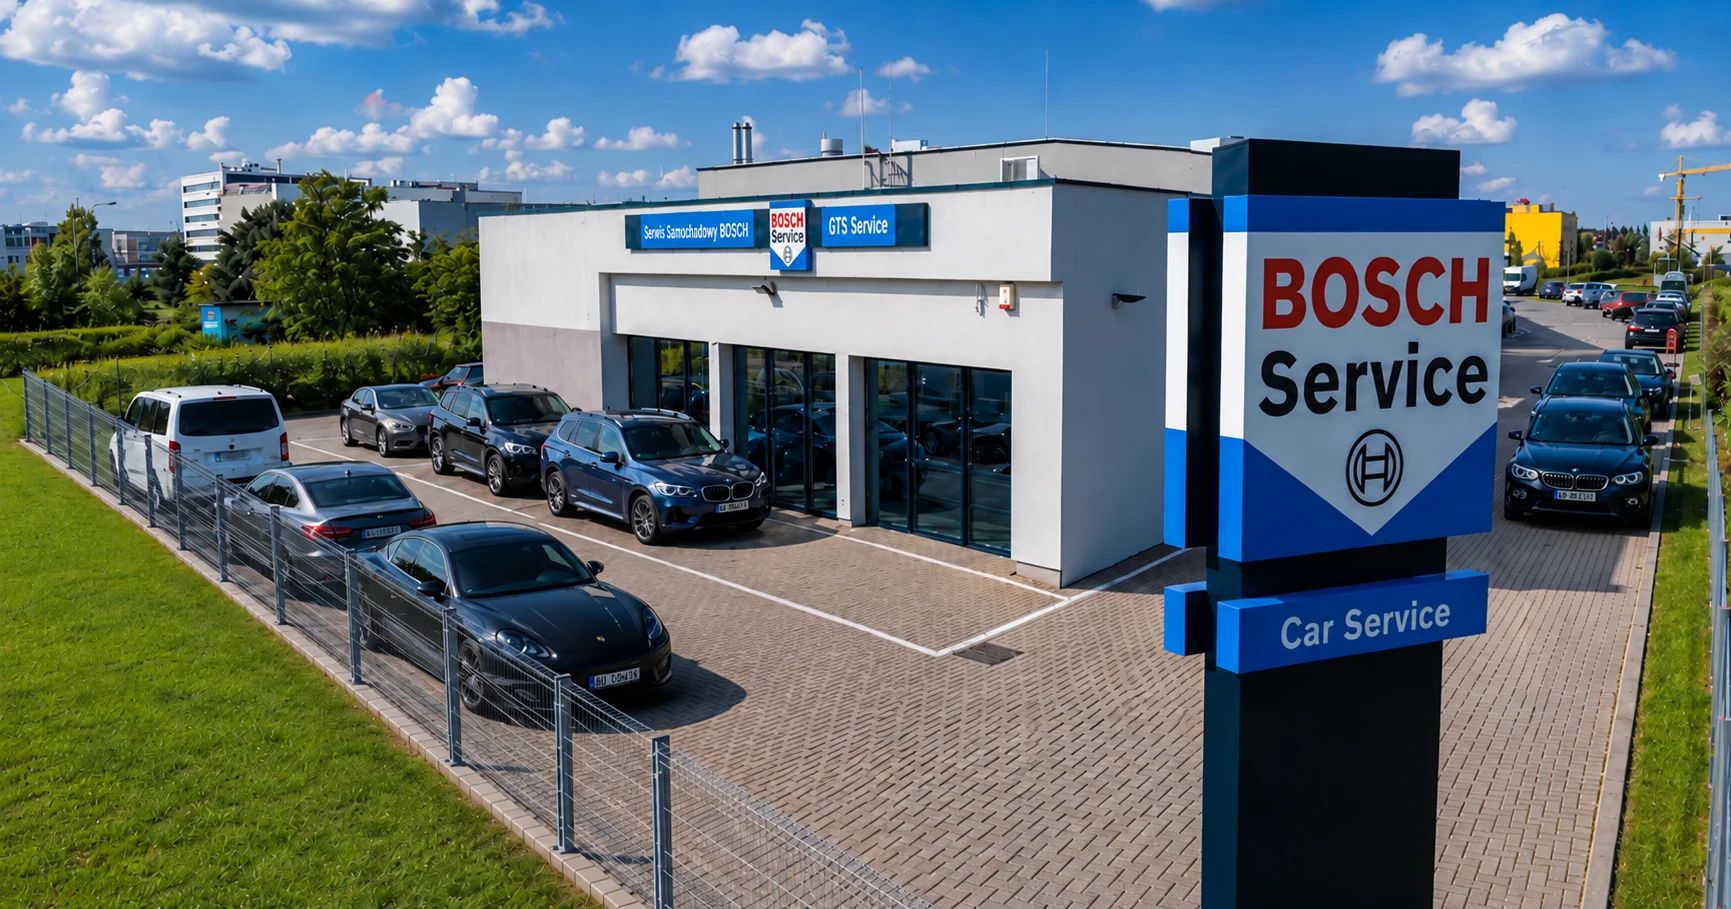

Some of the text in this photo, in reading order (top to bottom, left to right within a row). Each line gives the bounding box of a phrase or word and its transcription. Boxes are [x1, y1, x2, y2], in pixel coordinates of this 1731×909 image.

[644, 224, 665, 240] Serwis
[719, 222, 748, 238] BOSCH
[771, 212, 804, 228] BOSCH
[828, 214, 888, 236] GTS Service
[771, 229, 804, 244] Service
[1262, 256, 1490, 329] BOSCH
[1258, 341, 1488, 417] Service
[1280, 599, 1451, 650] Car Service
